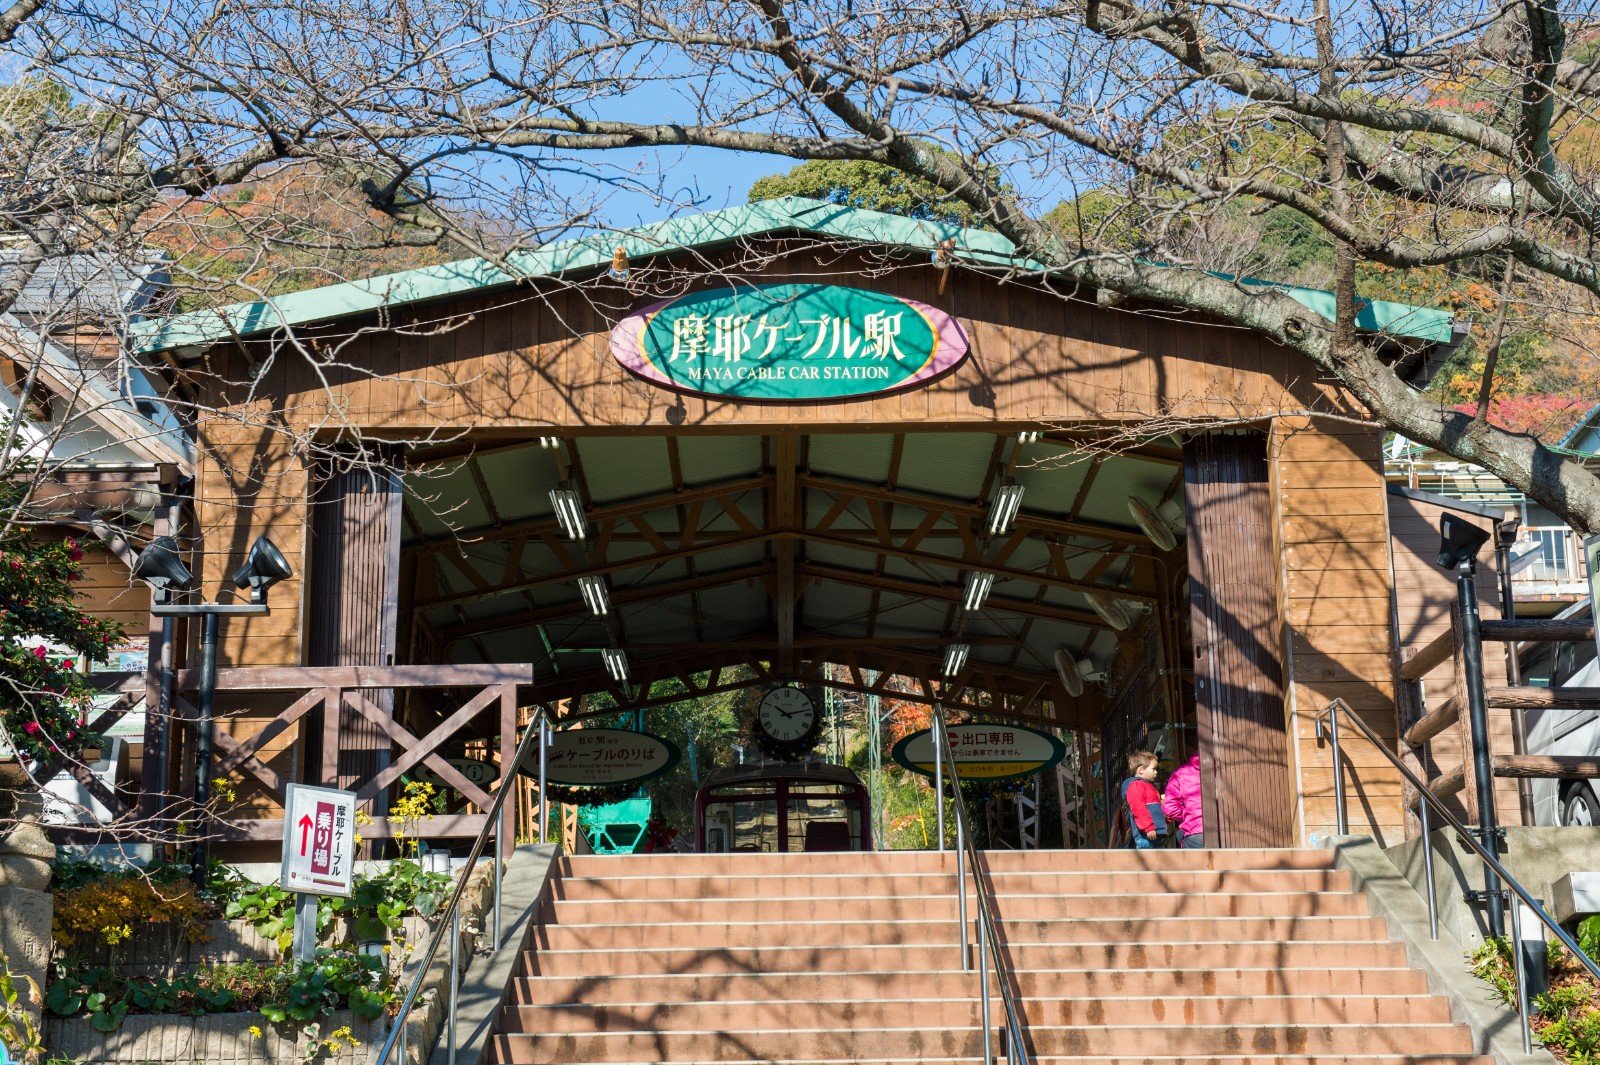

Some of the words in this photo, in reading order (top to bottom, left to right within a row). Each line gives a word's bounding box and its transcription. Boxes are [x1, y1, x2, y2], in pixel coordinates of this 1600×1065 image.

[669, 310, 906, 363] 摩耶ケーブル駅
[688, 366, 733, 380] MAYA
[736, 366, 785, 380] CABLE
[789, 366, 820, 379] CAR
[823, 366, 889, 379] STATION
[566, 748, 656, 761] ケーブルのりば
[962, 732, 1014, 745] 出口専用
[313, 811, 332, 868] 乗り場
[331, 804, 347, 877] 摩耶ケーブル
